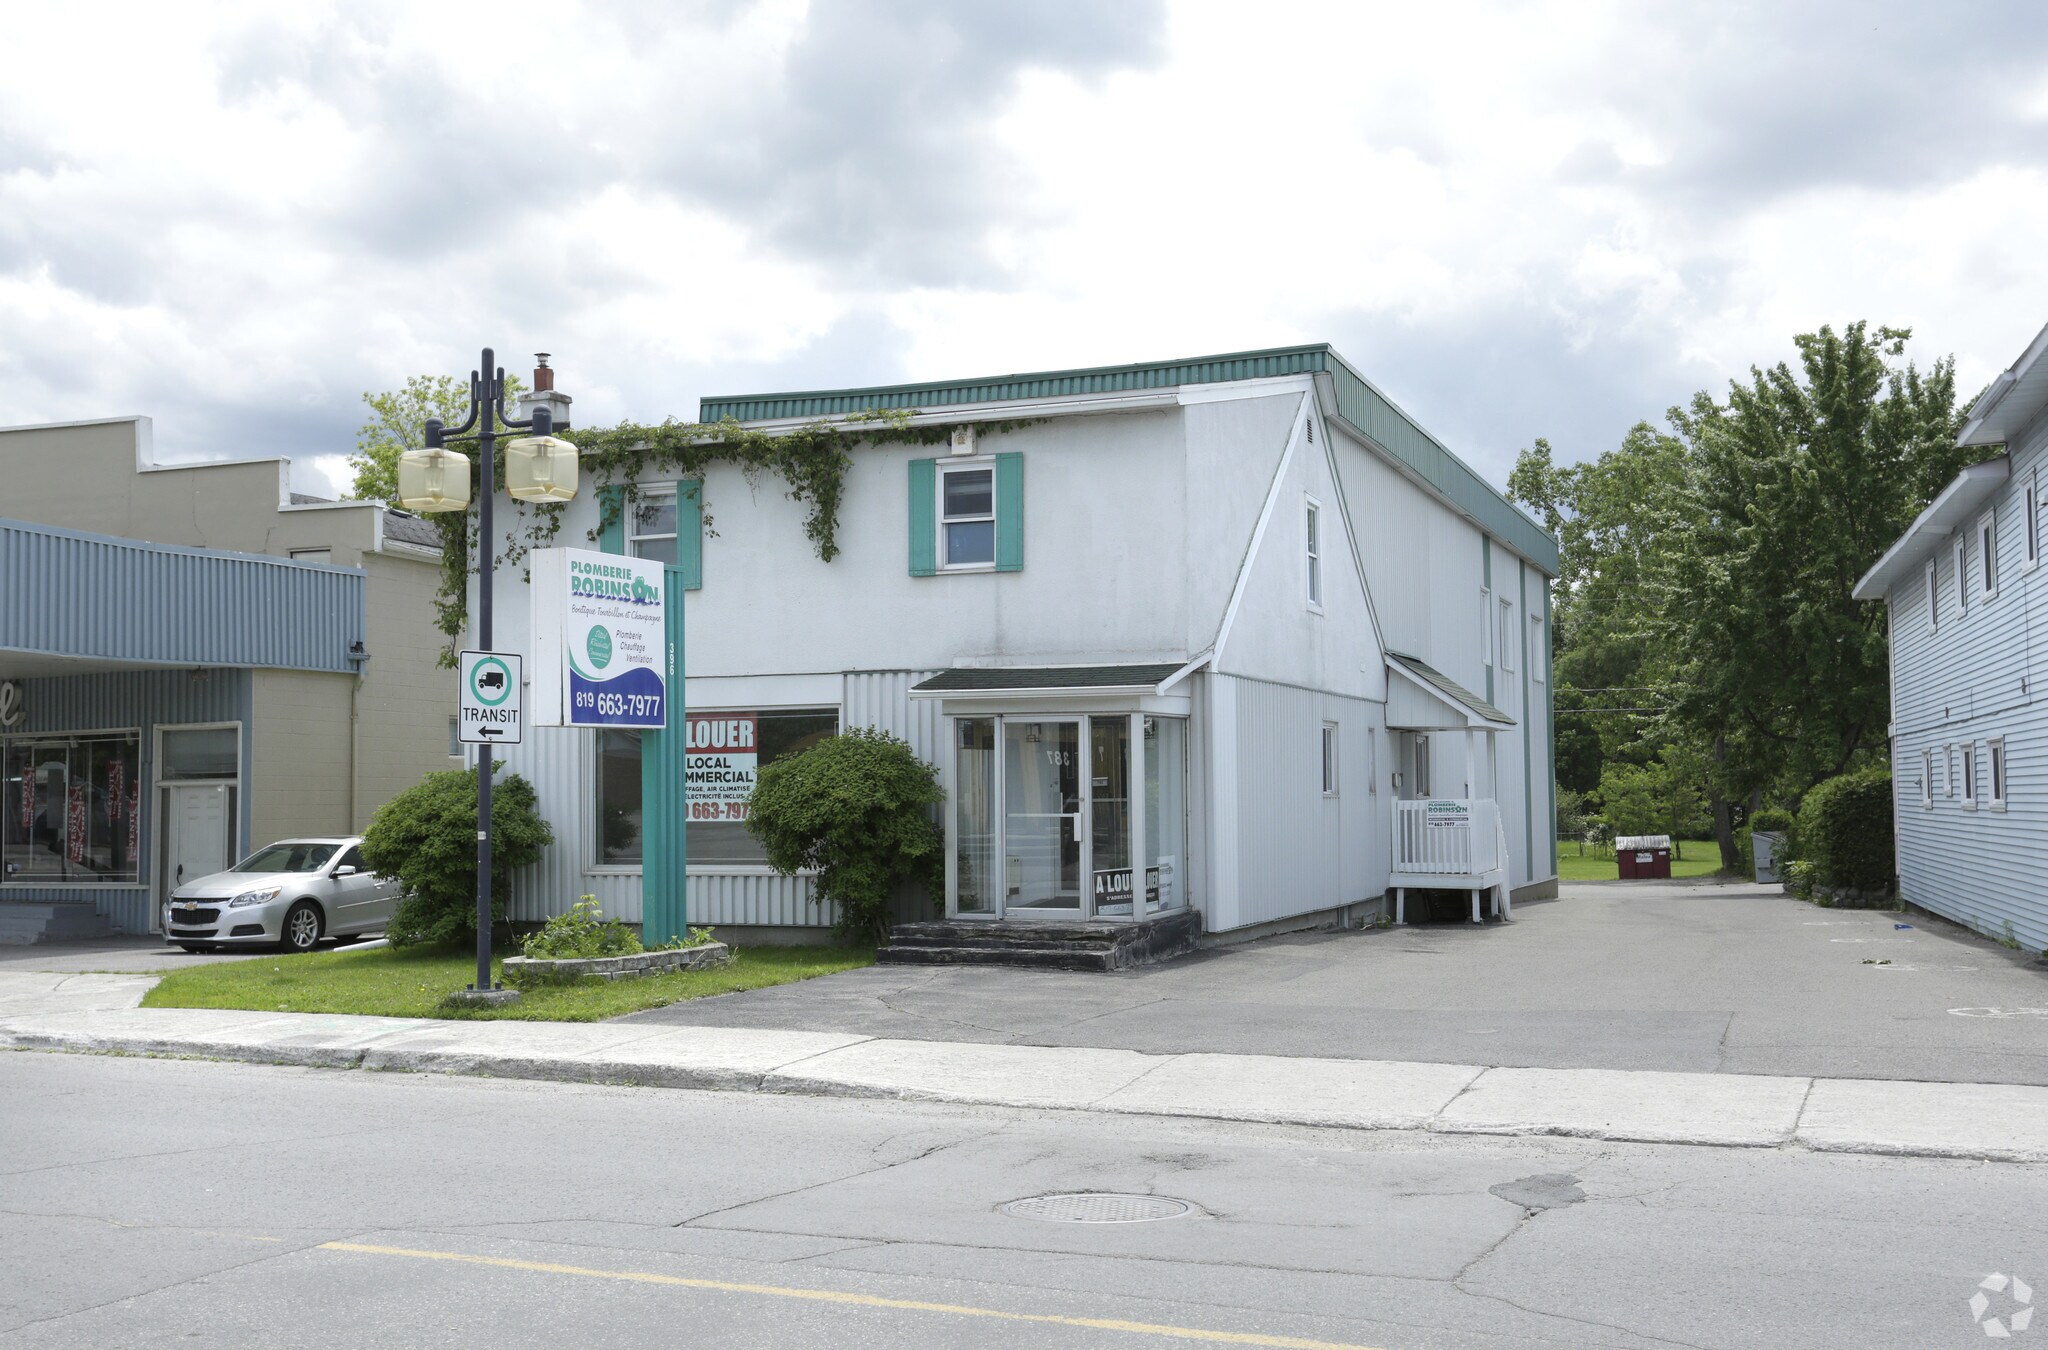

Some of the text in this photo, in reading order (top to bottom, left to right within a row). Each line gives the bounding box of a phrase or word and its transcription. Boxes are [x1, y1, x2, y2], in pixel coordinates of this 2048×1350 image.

[571, 560, 632, 580] PLOMBERIE
[571, 576, 660, 603] ROBINSON
[571, 604, 597, 618] Boutique
[631, 610, 661, 625] Champagne
[616, 629, 642, 640] Plomberie
[620, 641, 646, 653] Chauffage
[626, 653, 653, 663] Ventilation
[576, 691, 661, 717] 819 663-7977
[463, 708, 518, 723] TRANSIT
[686, 720, 754, 748] LOUER
[687, 757, 731, 769] LOCAL
[685, 771, 753, 783] MMERCIAL
[1095, 872, 1133, 894] A LOU
[1106, 893, 1133, 901] S'ADRESSE
